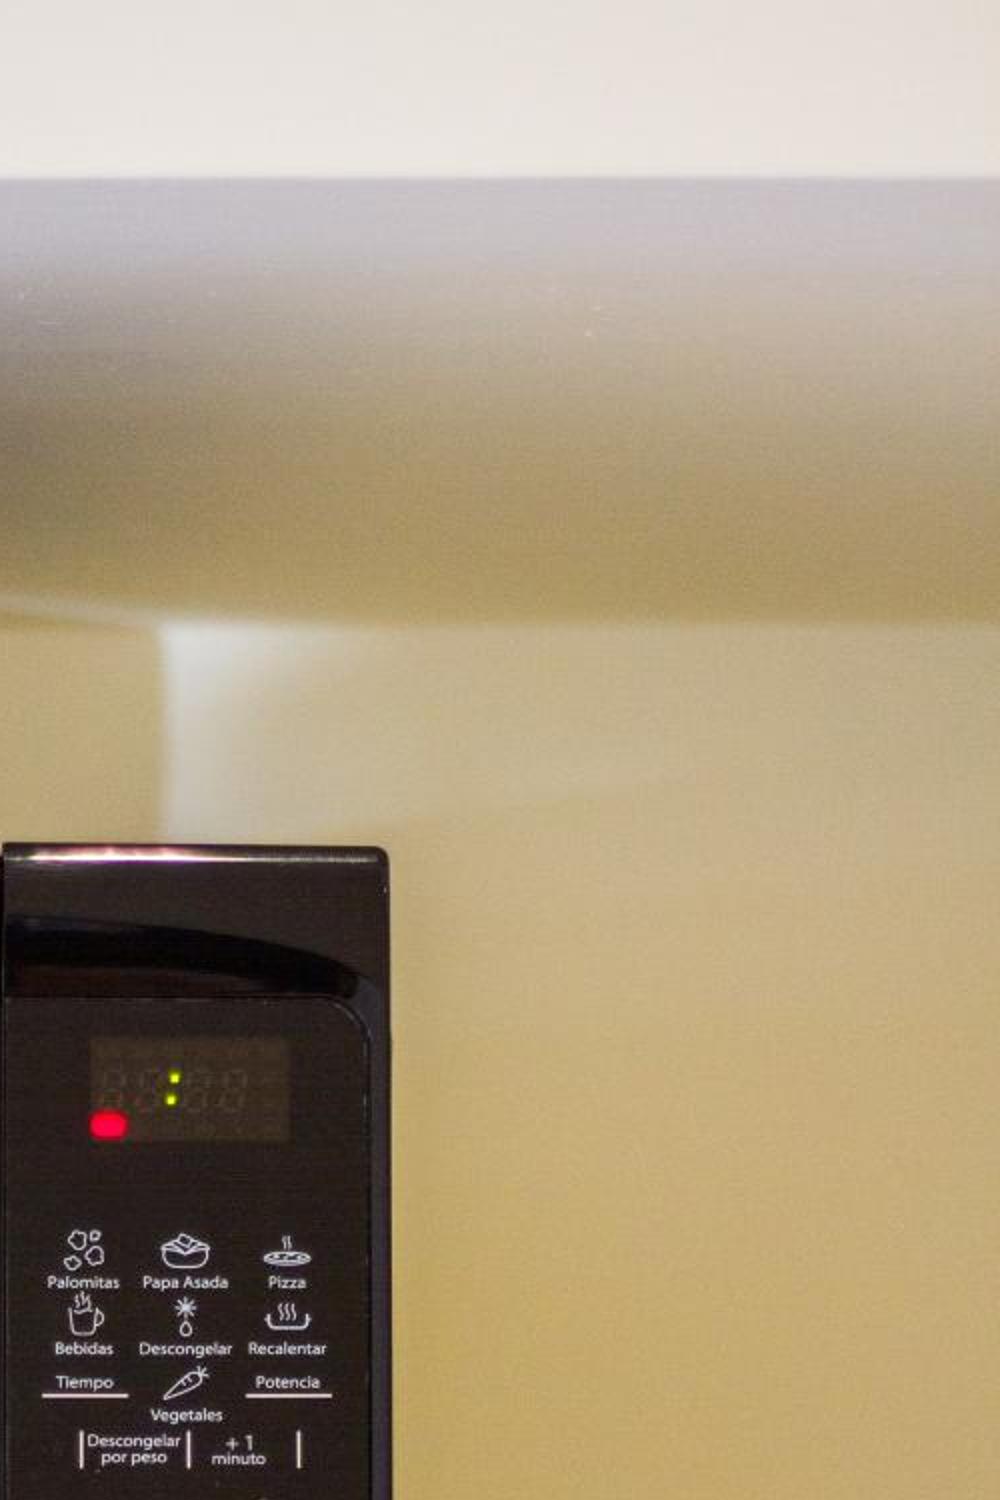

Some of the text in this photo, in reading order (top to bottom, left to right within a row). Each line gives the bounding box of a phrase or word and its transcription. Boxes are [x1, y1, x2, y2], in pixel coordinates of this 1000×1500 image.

[48, 1275, 120, 1288] Palomitas
[143, 1276, 228, 1291] Papa Asada
[269, 1276, 306, 1288] Pizza
[55, 1342, 113, 1355] Bebidas
[140, 1342, 232, 1358] Descongelar
[249, 1342, 326, 1355] Recalentar
[56, 1376, 114, 1391] Tiempo
[256, 1376, 320, 1388] Potencia
[151, 1408, 222, 1424] Vegetales
[88, 1434, 180, 1450] Descongelar
[102, 1453, 167, 1466] por peso
[212, 1452, 266, 1464] minuto
